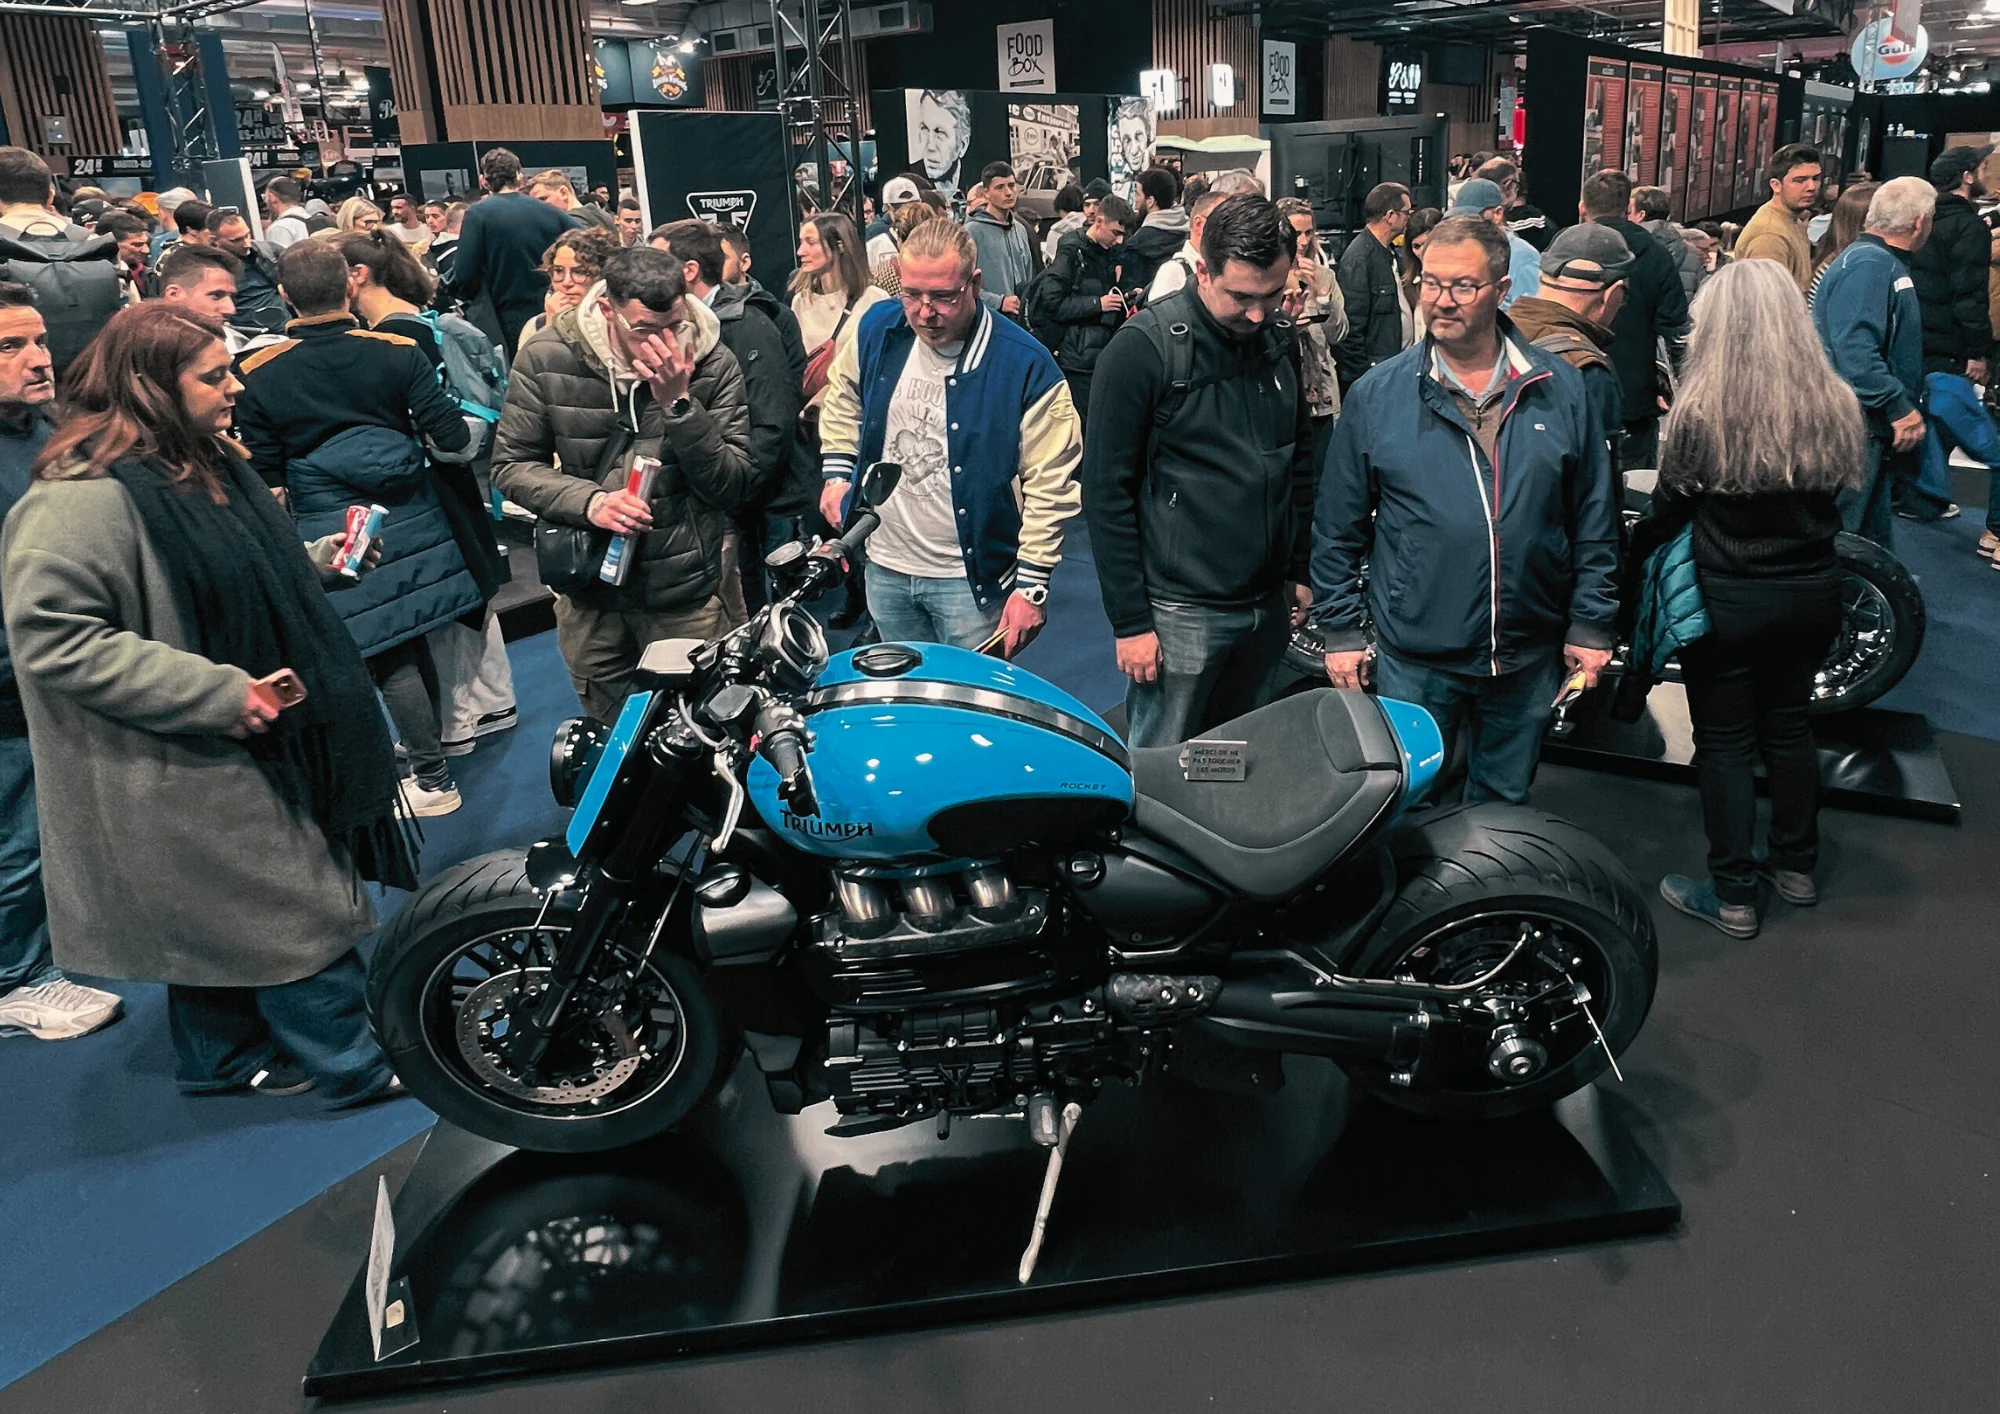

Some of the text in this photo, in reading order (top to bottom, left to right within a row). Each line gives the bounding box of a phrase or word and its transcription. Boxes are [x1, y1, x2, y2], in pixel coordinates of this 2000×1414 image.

[1008, 33, 1043, 60] FOOD
[1008, 57, 1046, 77] BOX
[1269, 51, 1290, 77] FOOD
[700, 196, 744, 210] TRIUMPH
[1059, 782, 1107, 791] ROCKET
[779, 809, 874, 842] TRIUMPH
